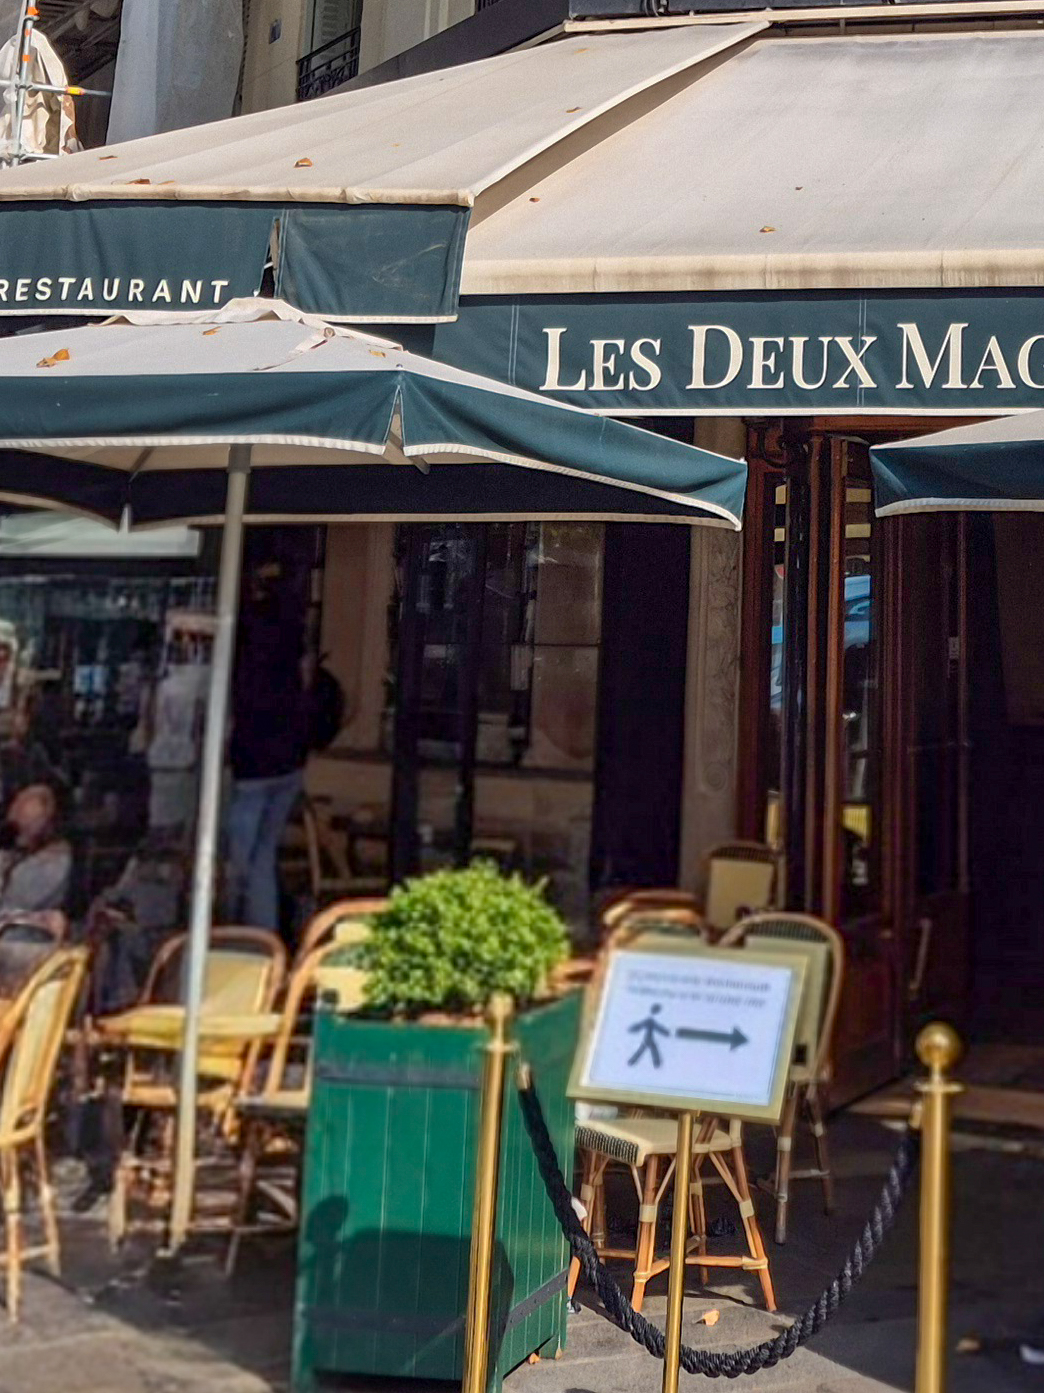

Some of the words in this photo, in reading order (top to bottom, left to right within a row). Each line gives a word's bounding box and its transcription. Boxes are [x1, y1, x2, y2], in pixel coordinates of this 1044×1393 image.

[0, 276, 229, 304] RESTAURANT
[539, 328, 662, 392] LES
[686, 324, 879, 391] DEUX
